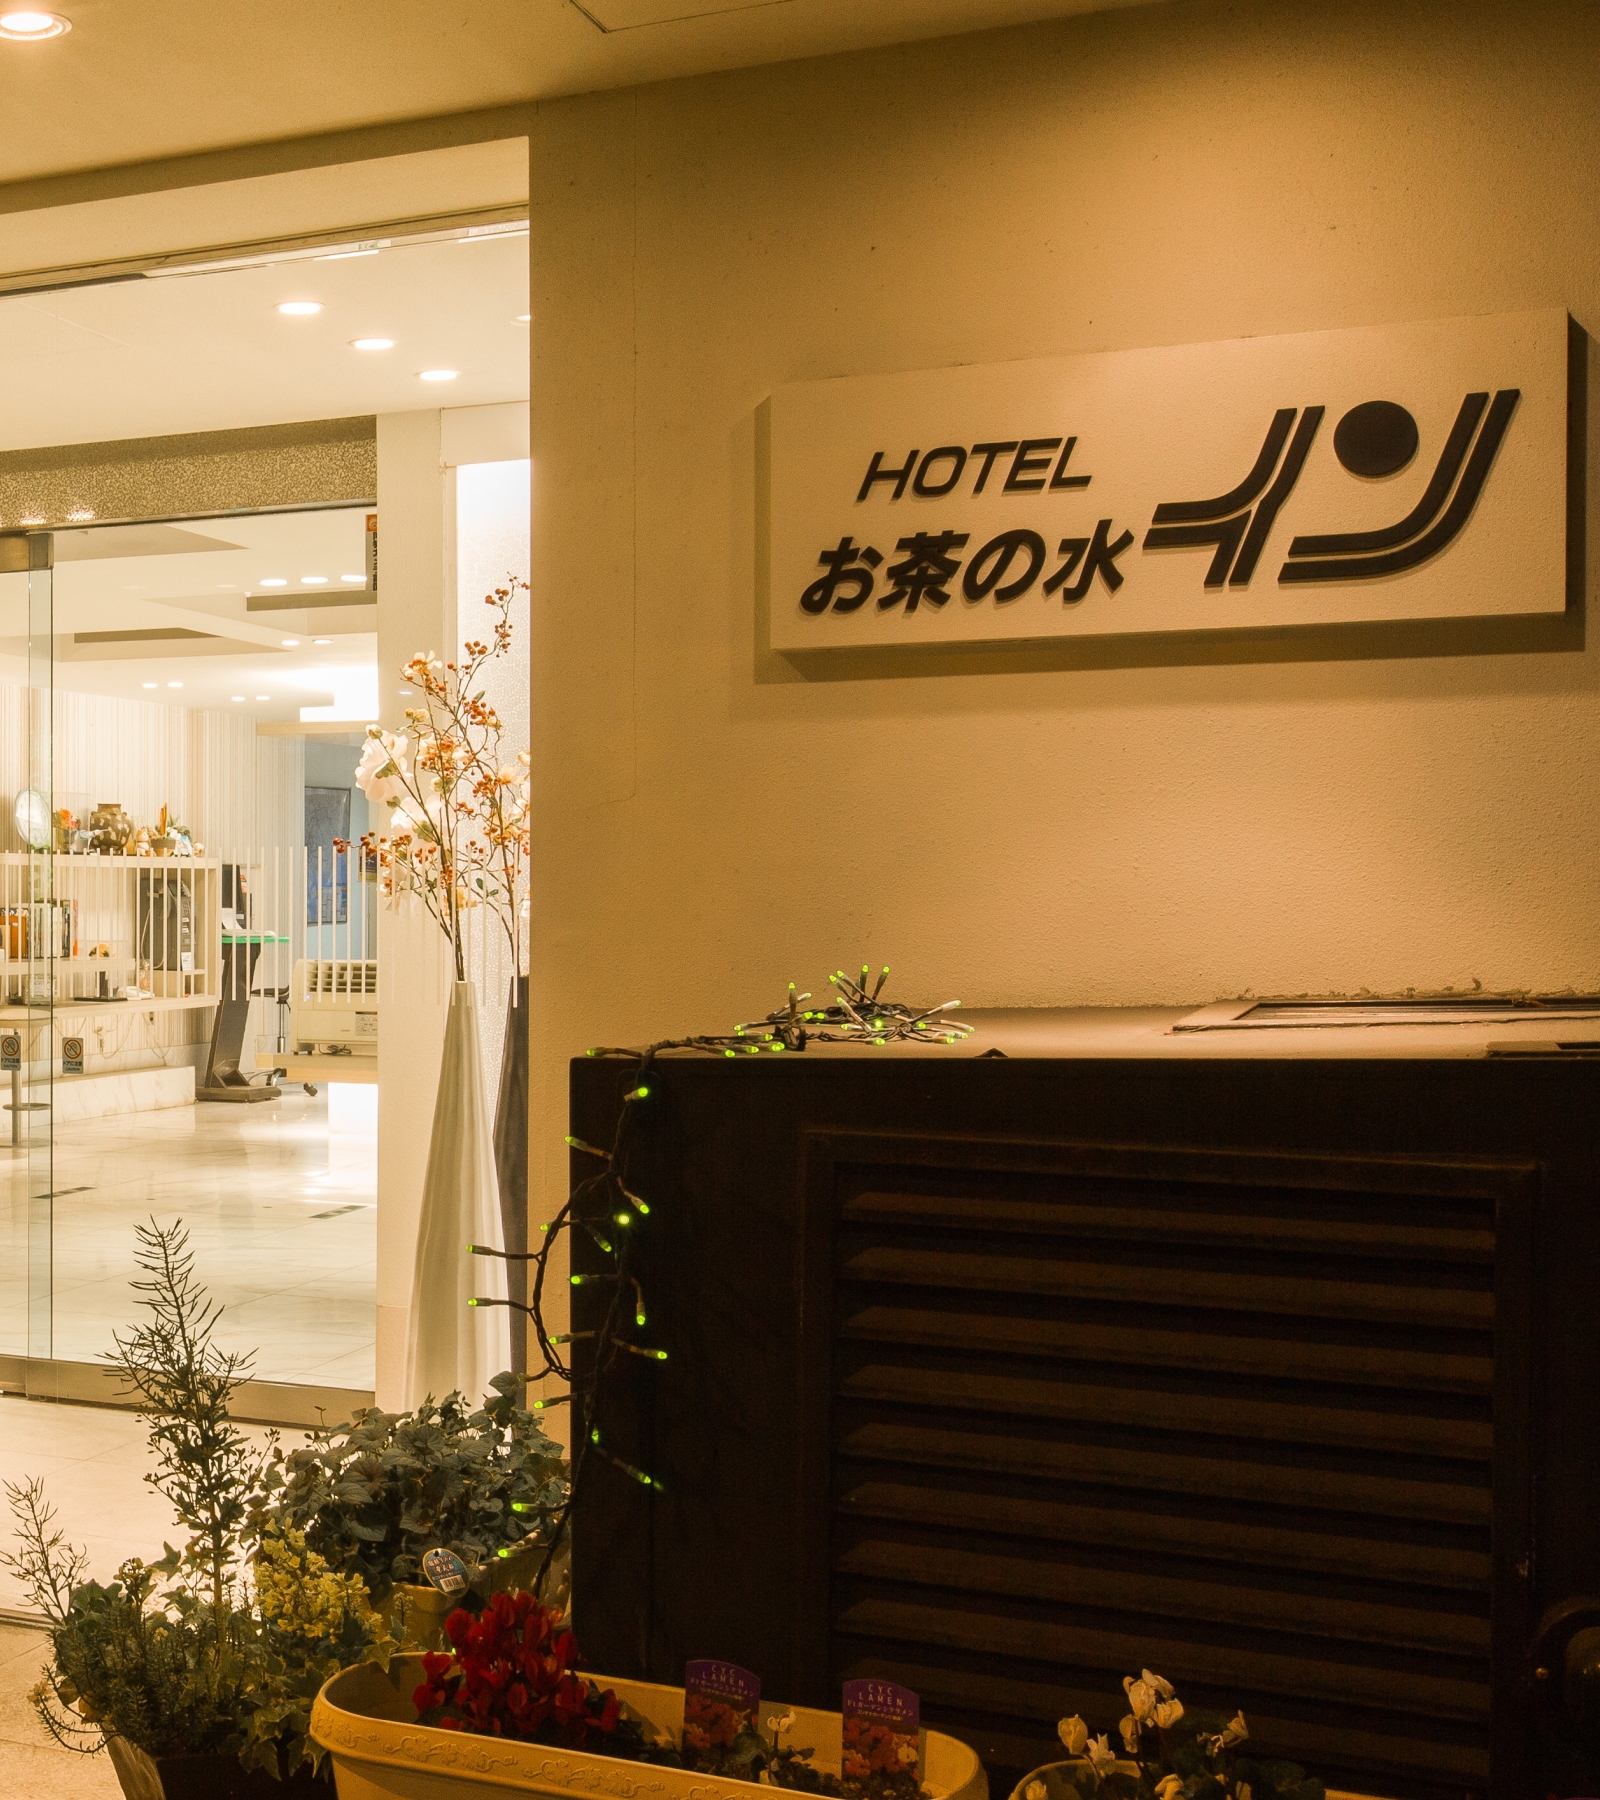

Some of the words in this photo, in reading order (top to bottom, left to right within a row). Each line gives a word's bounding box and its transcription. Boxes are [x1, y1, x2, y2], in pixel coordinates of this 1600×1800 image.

[856, 437, 1092, 501] HOTEL
[800, 519, 1134, 613] お茶の水
[711, 1665, 735, 1677] CYC
[702, 1671, 745, 1687] LAMEN
[868, 1684, 893, 1696] CYC
[858, 1692, 903, 1707] LAMEN
